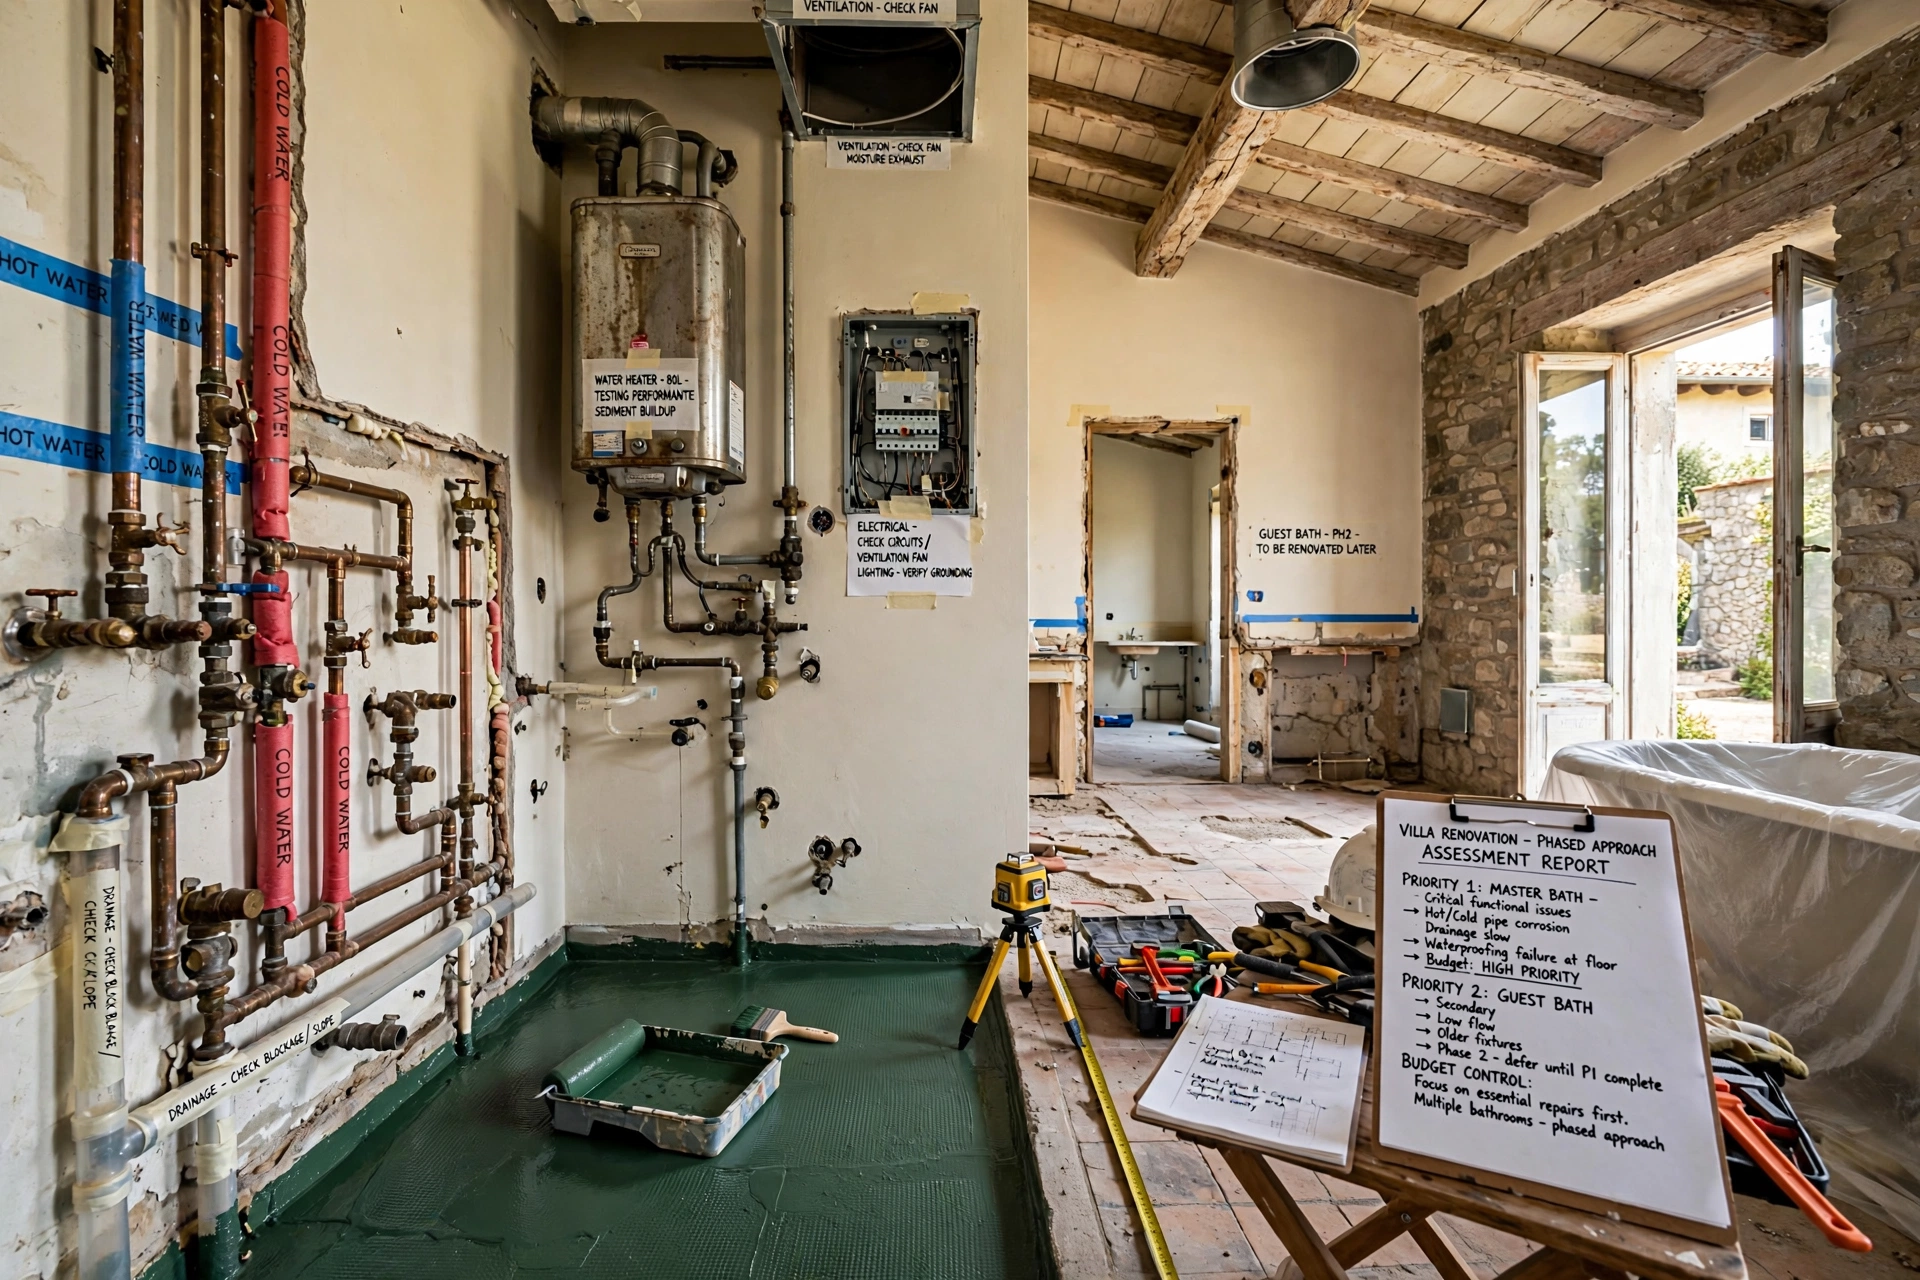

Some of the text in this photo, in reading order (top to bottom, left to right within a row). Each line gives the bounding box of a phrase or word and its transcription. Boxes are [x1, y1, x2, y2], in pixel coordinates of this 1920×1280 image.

[804, 0, 873, 12] VENTILATION
[884, 2, 916, 14] CHECK
[919, 3, 938, 14] FAN
[275, 66, 290, 118] COLD
[926, 142, 942, 152] FAN
[0, 250, 108, 304] HOT WATER
[272, 325, 288, 377] COLD
[594, 375, 623, 385] WATER
[626, 374, 658, 385] HEATER
[666, 374, 682, 385] 80L
[594, 390, 629, 401] TESTING
[594, 406, 637, 417] SEDIMENT
[42, 433, 106, 462] WATER
[857, 521, 910, 532] ELECTRICAL
[1259, 529, 1292, 539] GUEST
[1295, 529, 1321, 539] BATH
[1332, 529, 1352, 540] PH2
[857, 537, 884, 547] CHECK
[1256, 543, 1377, 555] TO BE RENOVATED LATER
[857, 552, 928, 563] VENTILATION FAN
[857, 567, 895, 578] LIGHTING
[276, 748, 291, 798] COLD
[338, 746, 350, 853] COLD WATER
[1399, 823, 1435, 839] VILLA
[1442, 827, 1517, 845] RENOVATION
[1537, 834, 1585, 851] PHASED
[1592, 840, 1657, 858] APPROACH
[1422, 844, 1610, 874] ASSESSMENT REPORT
[1402, 872, 1459, 891] PRIORITY
[1467, 880, 1482, 892] 1:
[1490, 883, 1542, 900] MASTER
[1549, 889, 1583, 903] BATH
[1425, 892, 1571, 918] Critical functional issues
[83, 900, 97, 944] CHECK
[1425, 906, 1570, 934] Hot/Cold pipe corrosion
[1425, 921, 1510, 942] Drainage slow
[1425, 937, 1617, 970] Waterproofing failure at floor
[1427, 953, 1580, 985] Budget: HIGH PRIORITY
[1402, 972, 1593, 1015] PRIORITY 2: GUEST BATH
[1436, 996, 1496, 1021] Secondary
[1437, 1012, 1495, 1031] Low flow
[1437, 1027, 1523, 1051] Older fixtures
[168, 1083, 218, 1122] DRAINAGE
[230, 1058, 260, 1084] CHECK
[312, 1014, 335, 1036] SLOPE
[1402, 1052, 1532, 1088] BUDGET CONTROL:
[1437, 1042, 1471, 1059] Phase
[1478, 1050, 1488, 1062] 2
[1504, 1052, 1538, 1070] defer
[1545, 1062, 1574, 1077] until
[1604, 1072, 1663, 1092] complete
[1415, 1074, 1628, 1125] Focus on essential repairs first.
[1414, 1092, 1462, 1116] Multiple
[1470, 1100, 1533, 1127] bathrooms
[1552, 1118, 1596, 1138] phased
[1604, 1132, 1665, 1152] approach
